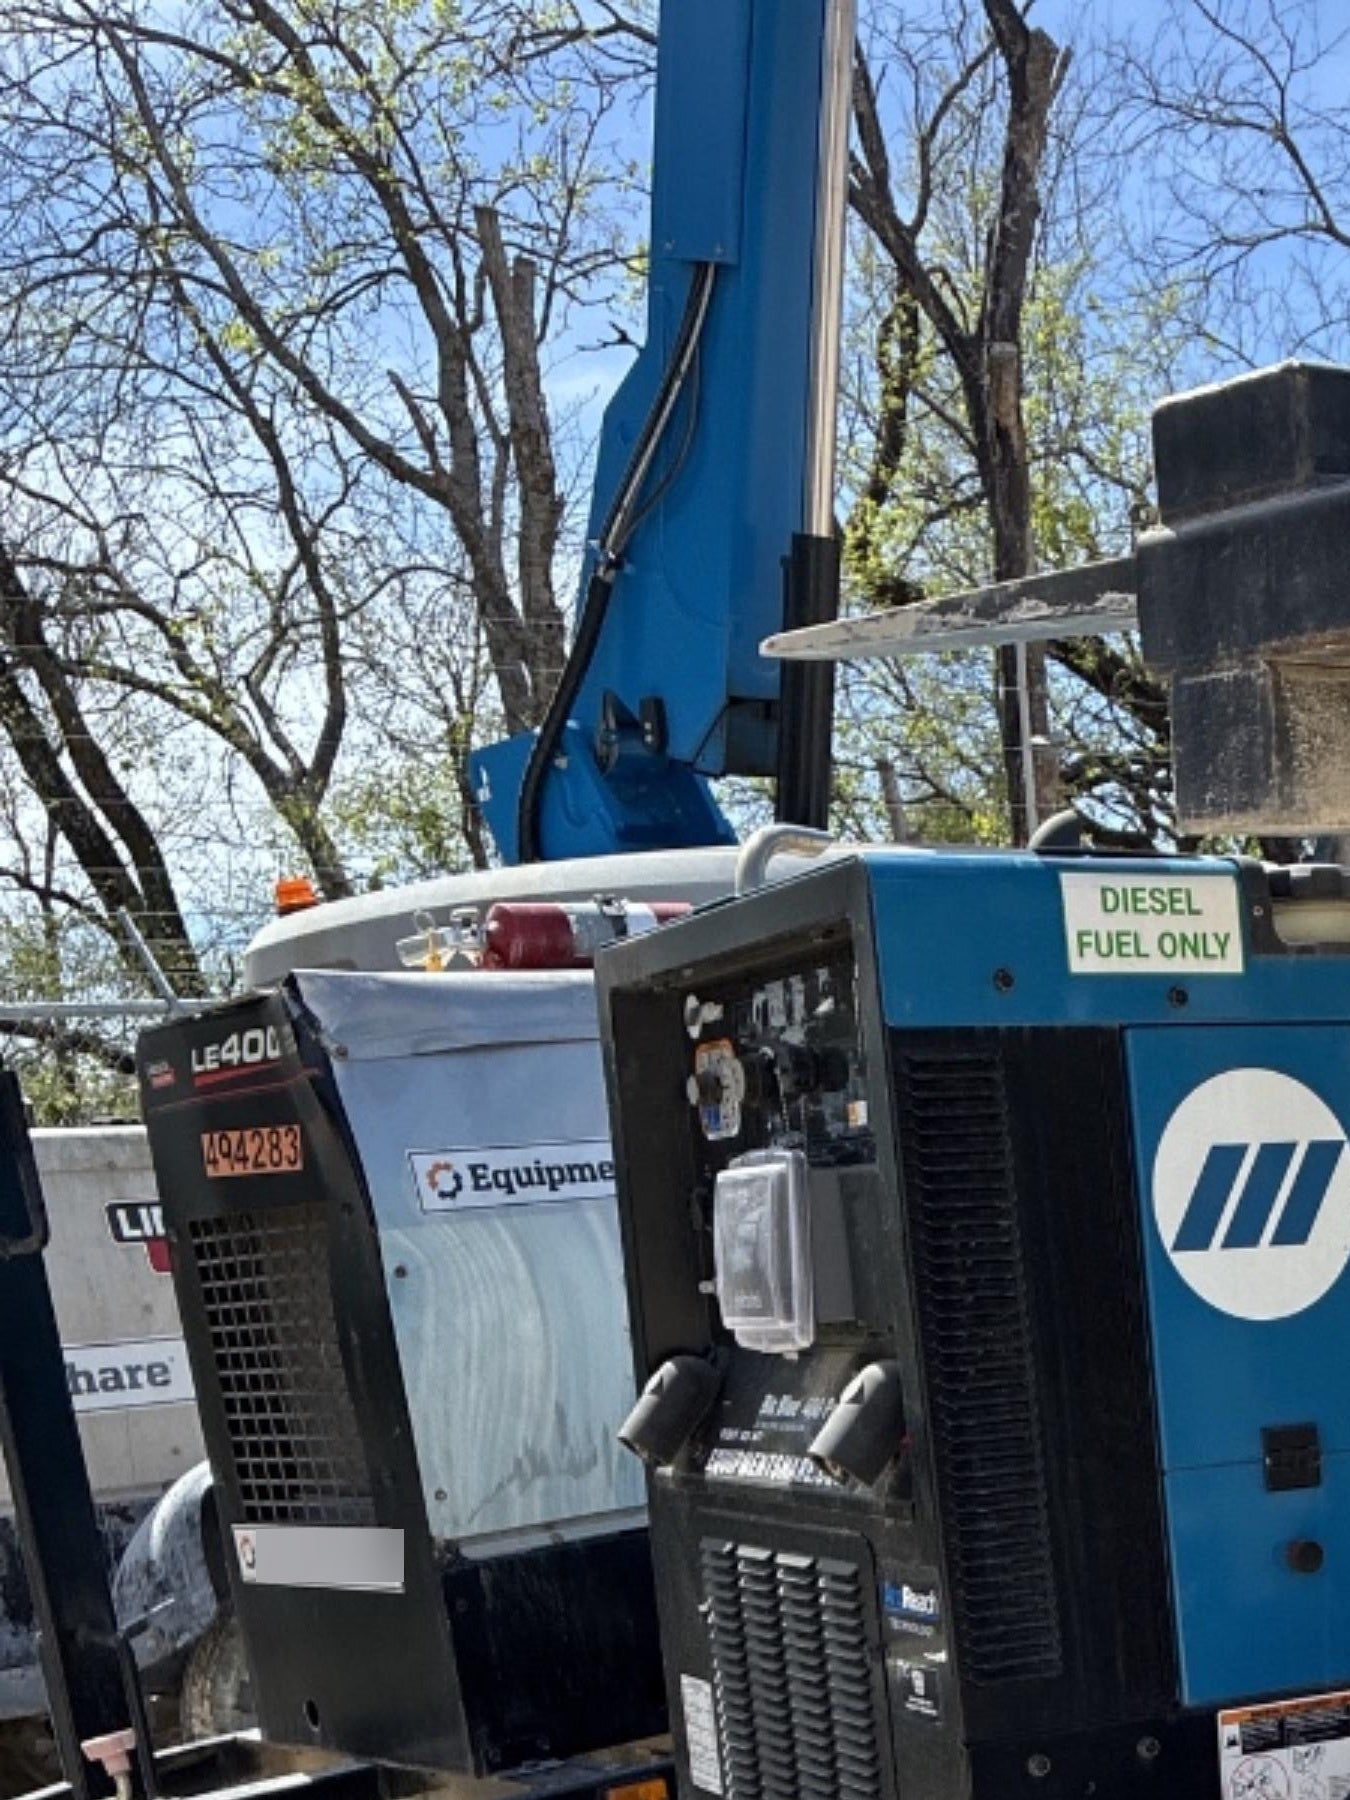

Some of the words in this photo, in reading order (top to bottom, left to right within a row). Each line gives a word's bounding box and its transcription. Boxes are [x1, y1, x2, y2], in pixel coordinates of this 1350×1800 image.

[1099, 885, 1203, 917] DIESEL
[1076, 929, 1150, 959] FUEL
[1157, 931, 1232, 961] ONLY
[205, 1126, 299, 1172] 494283
[467, 1159, 616, 1195] Equipme
[65, 1360, 173, 1395] hare
